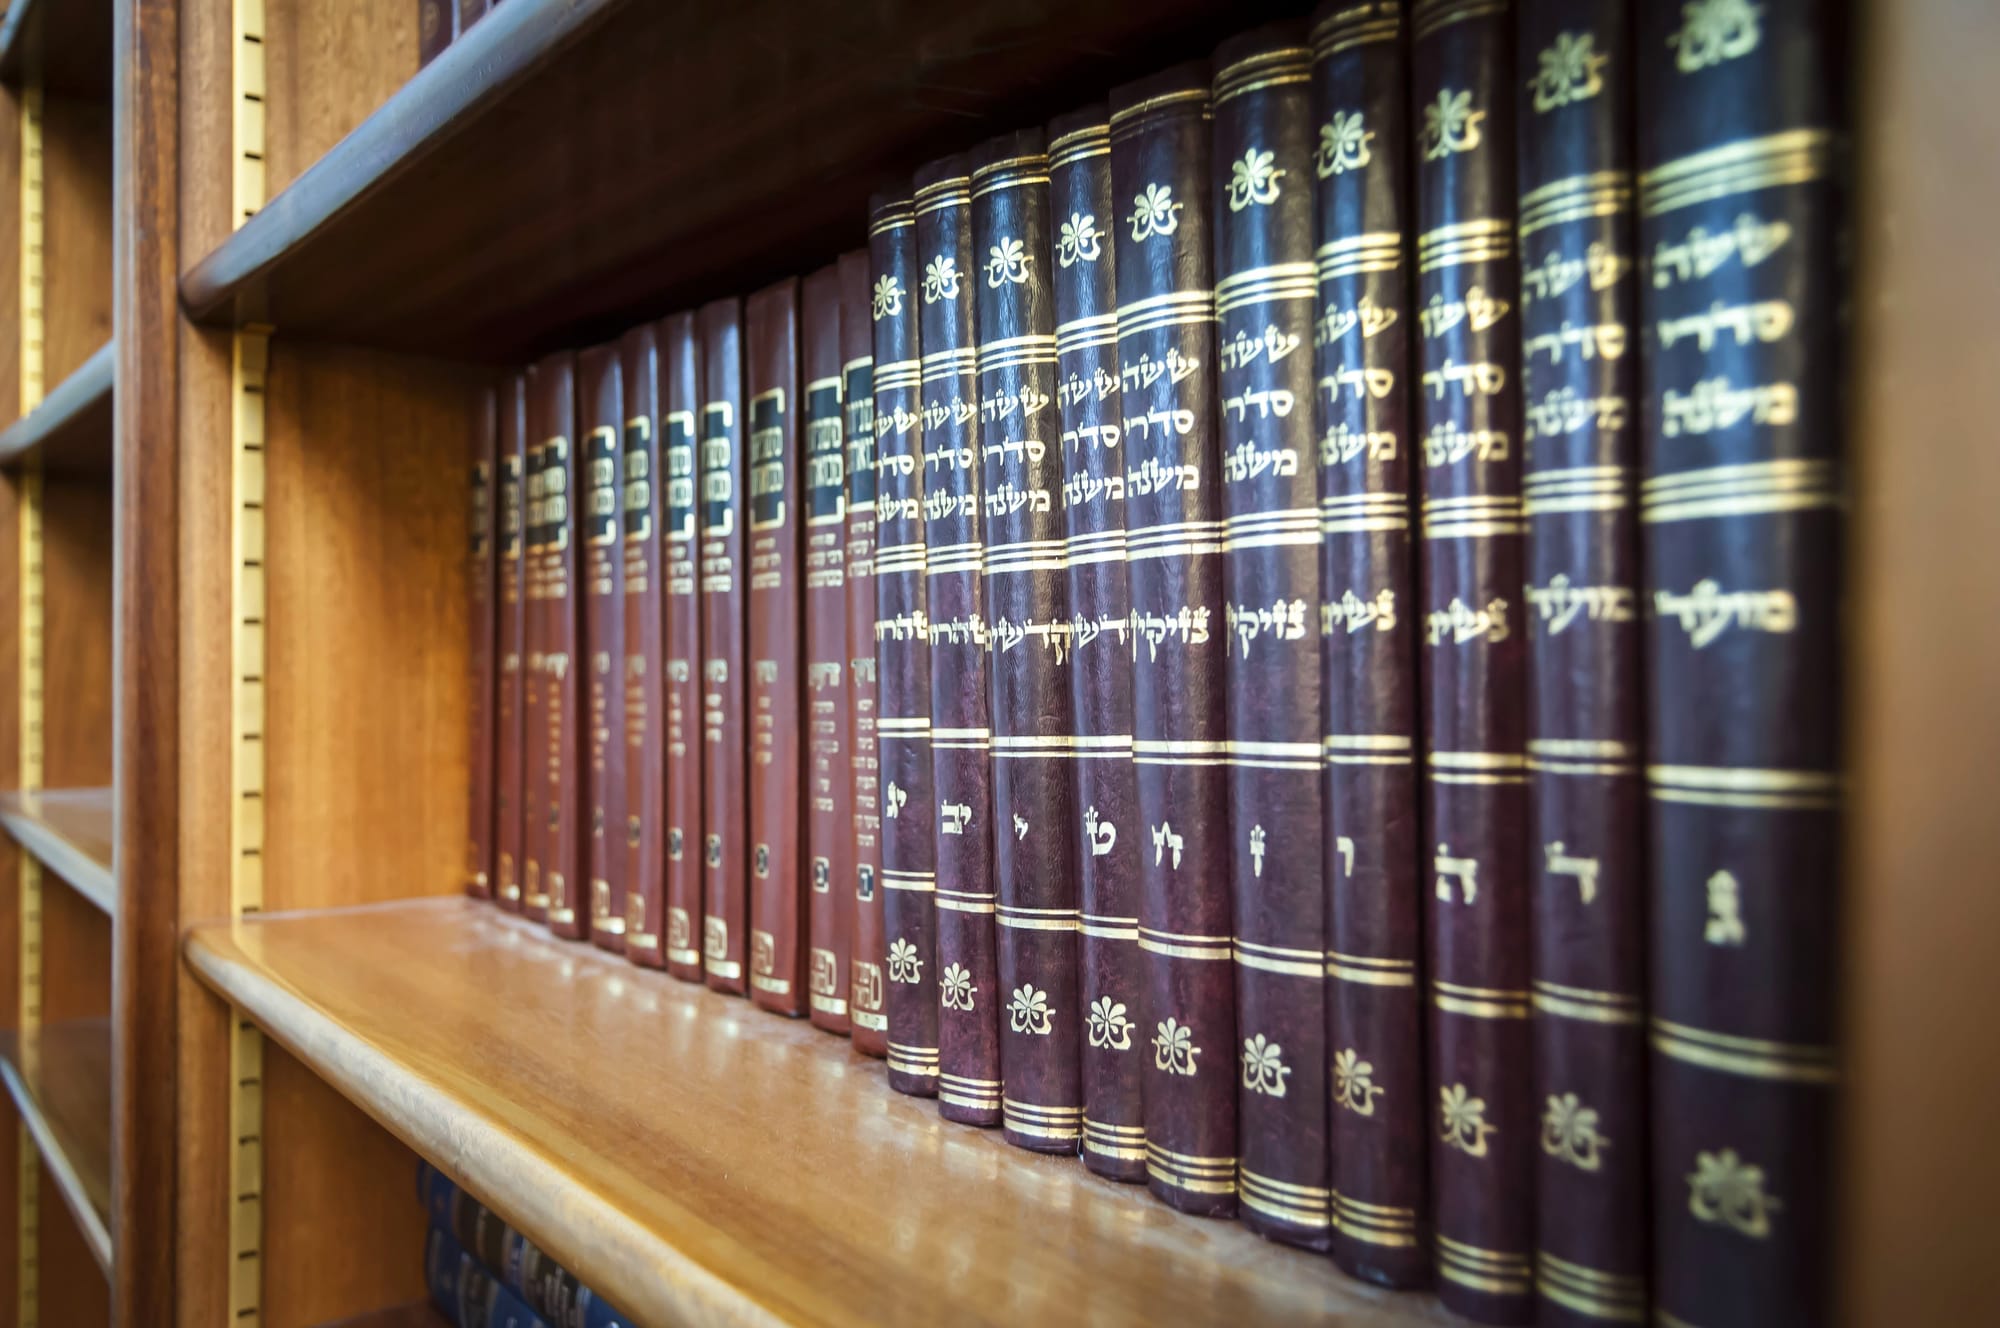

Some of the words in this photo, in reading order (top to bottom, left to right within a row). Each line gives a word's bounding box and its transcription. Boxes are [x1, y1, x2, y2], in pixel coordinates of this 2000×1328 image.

[1221, 323, 1301, 373] ששה
[1657, 299, 1794, 352] סדרי
[1122, 347, 1200, 393] ששה
[981, 384, 1049, 424] ששה
[1123, 406, 1195, 440] סדרי
[1222, 385, 1296, 423] סדרי
[982, 436, 1046, 467] סדרי
[1224, 439, 1298, 484] משנה
[985, 481, 1051, 518] משנה
[1127, 456, 1200, 498] משנה
[1130, 605, 1211, 664] נזיקין
[1226, 598, 1307, 660] נזיקין
[941, 799, 972, 835] יב
[1084, 805, 1117, 856] ט
[1152, 821, 1183, 870] ח
[1434, 843, 1477, 905] ה
